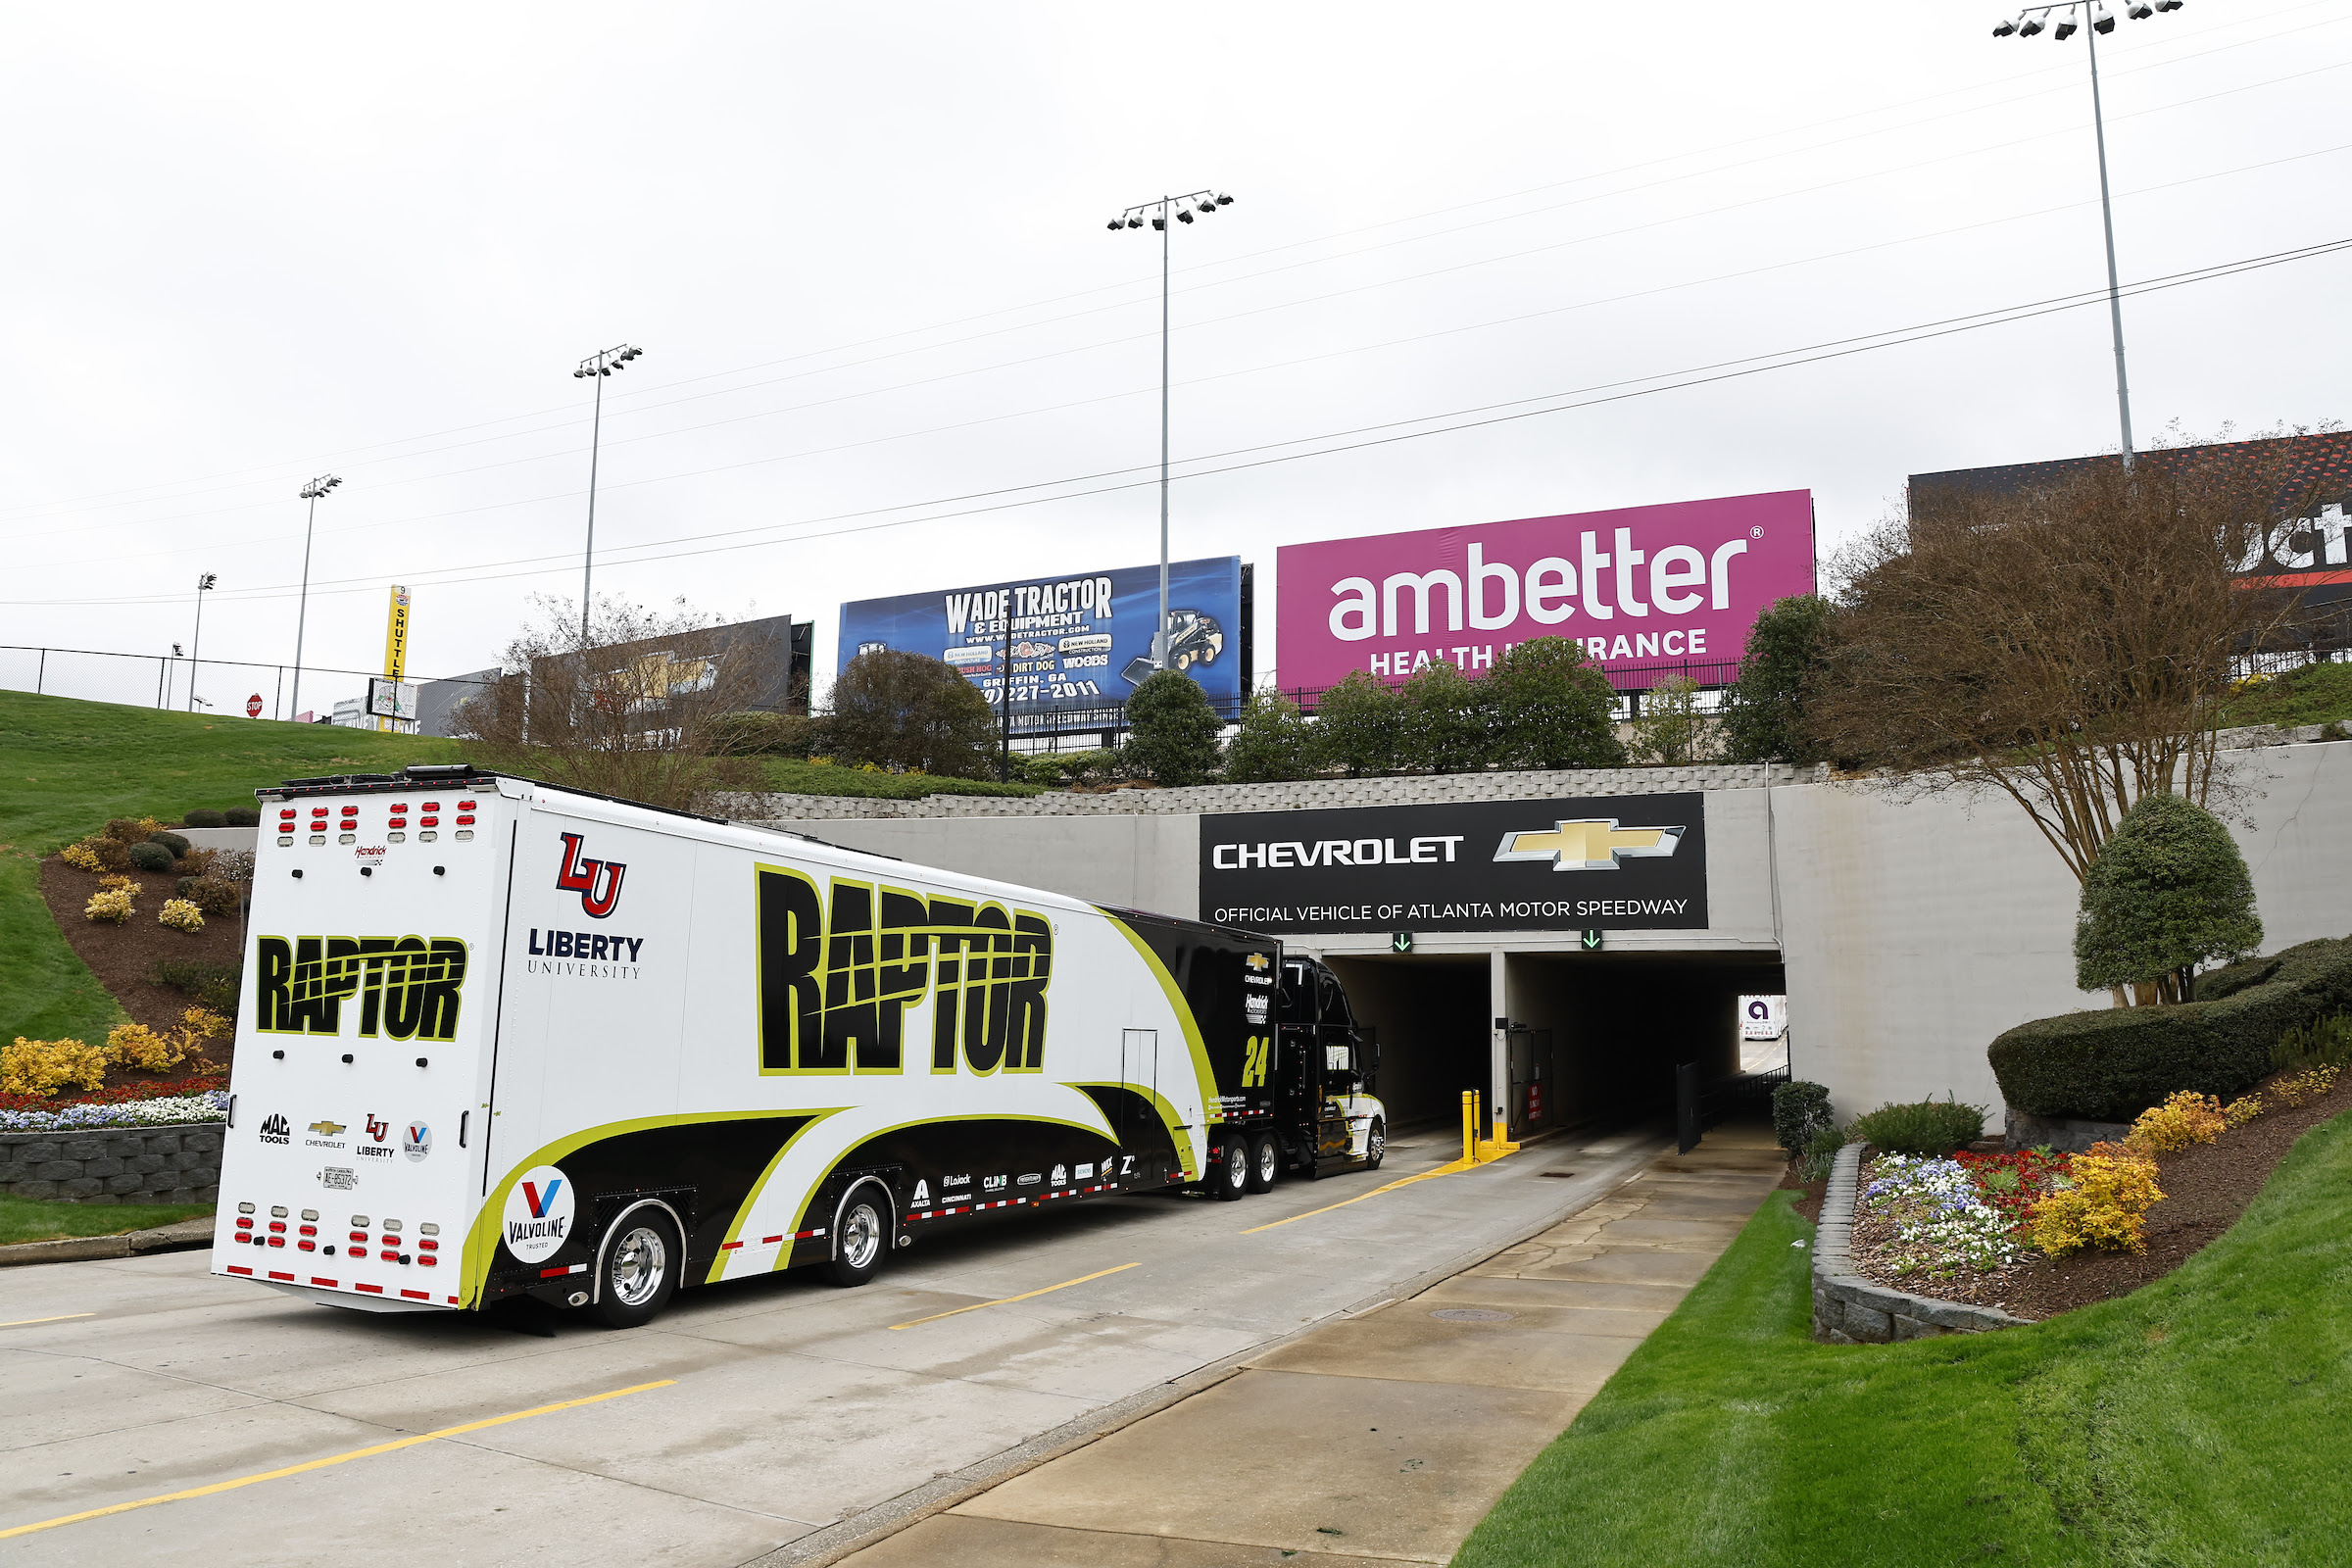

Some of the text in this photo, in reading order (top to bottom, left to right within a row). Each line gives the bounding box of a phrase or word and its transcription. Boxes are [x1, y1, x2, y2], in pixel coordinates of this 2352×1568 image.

[1328, 526, 1747, 642] ambetter
[945, 576, 1112, 634] WADE TRACTOR
[974, 611, 1084, 634] & EQUIPMENT
[392, 609, 405, 676] SHUTTLE
[965, 625, 1090, 644] WWW.WDETRACTOR.COM
[1505, 628, 1707, 666] IRANCE
[1012, 660, 1055, 673] DIRT DOG
[1062, 654, 1108, 669] WOODS
[983, 675, 1045, 687] GRIFFIN,
[1048, 672, 1067, 682] GA
[247, 701, 263, 711] STOP
[354, 845, 387, 858] Hendrick
[1212, 835, 1464, 869] CHEVROLET
[556, 832, 627, 919] LU
[1214, 899, 1688, 923] OFFICIAL VEHICLE OF ATLANTA MOTOR SPEEDWAY
[528, 928, 644, 962] LIBERTY
[527, 959, 641, 980] UNIVERSITY
[754, 860, 1054, 1078] RAPTOR
[256, 933, 469, 1043] RAPTOR
[1242, 1035, 1270, 1088] 24
[260, 1113, 290, 1136] MAC
[259, 1135, 290, 1145] TOOLS
[305, 1139, 346, 1149] CHEVROLET
[404, 1142, 428, 1154] VALVOLINE
[357, 1146, 395, 1158] LIBERTY
[1052, 1163, 1067, 1180] MAC
[910, 1200, 931, 1208] AXALTA
[942, 1193, 972, 1203] CINCINNATI
[510, 1216, 565, 1245] VALVOLINE
